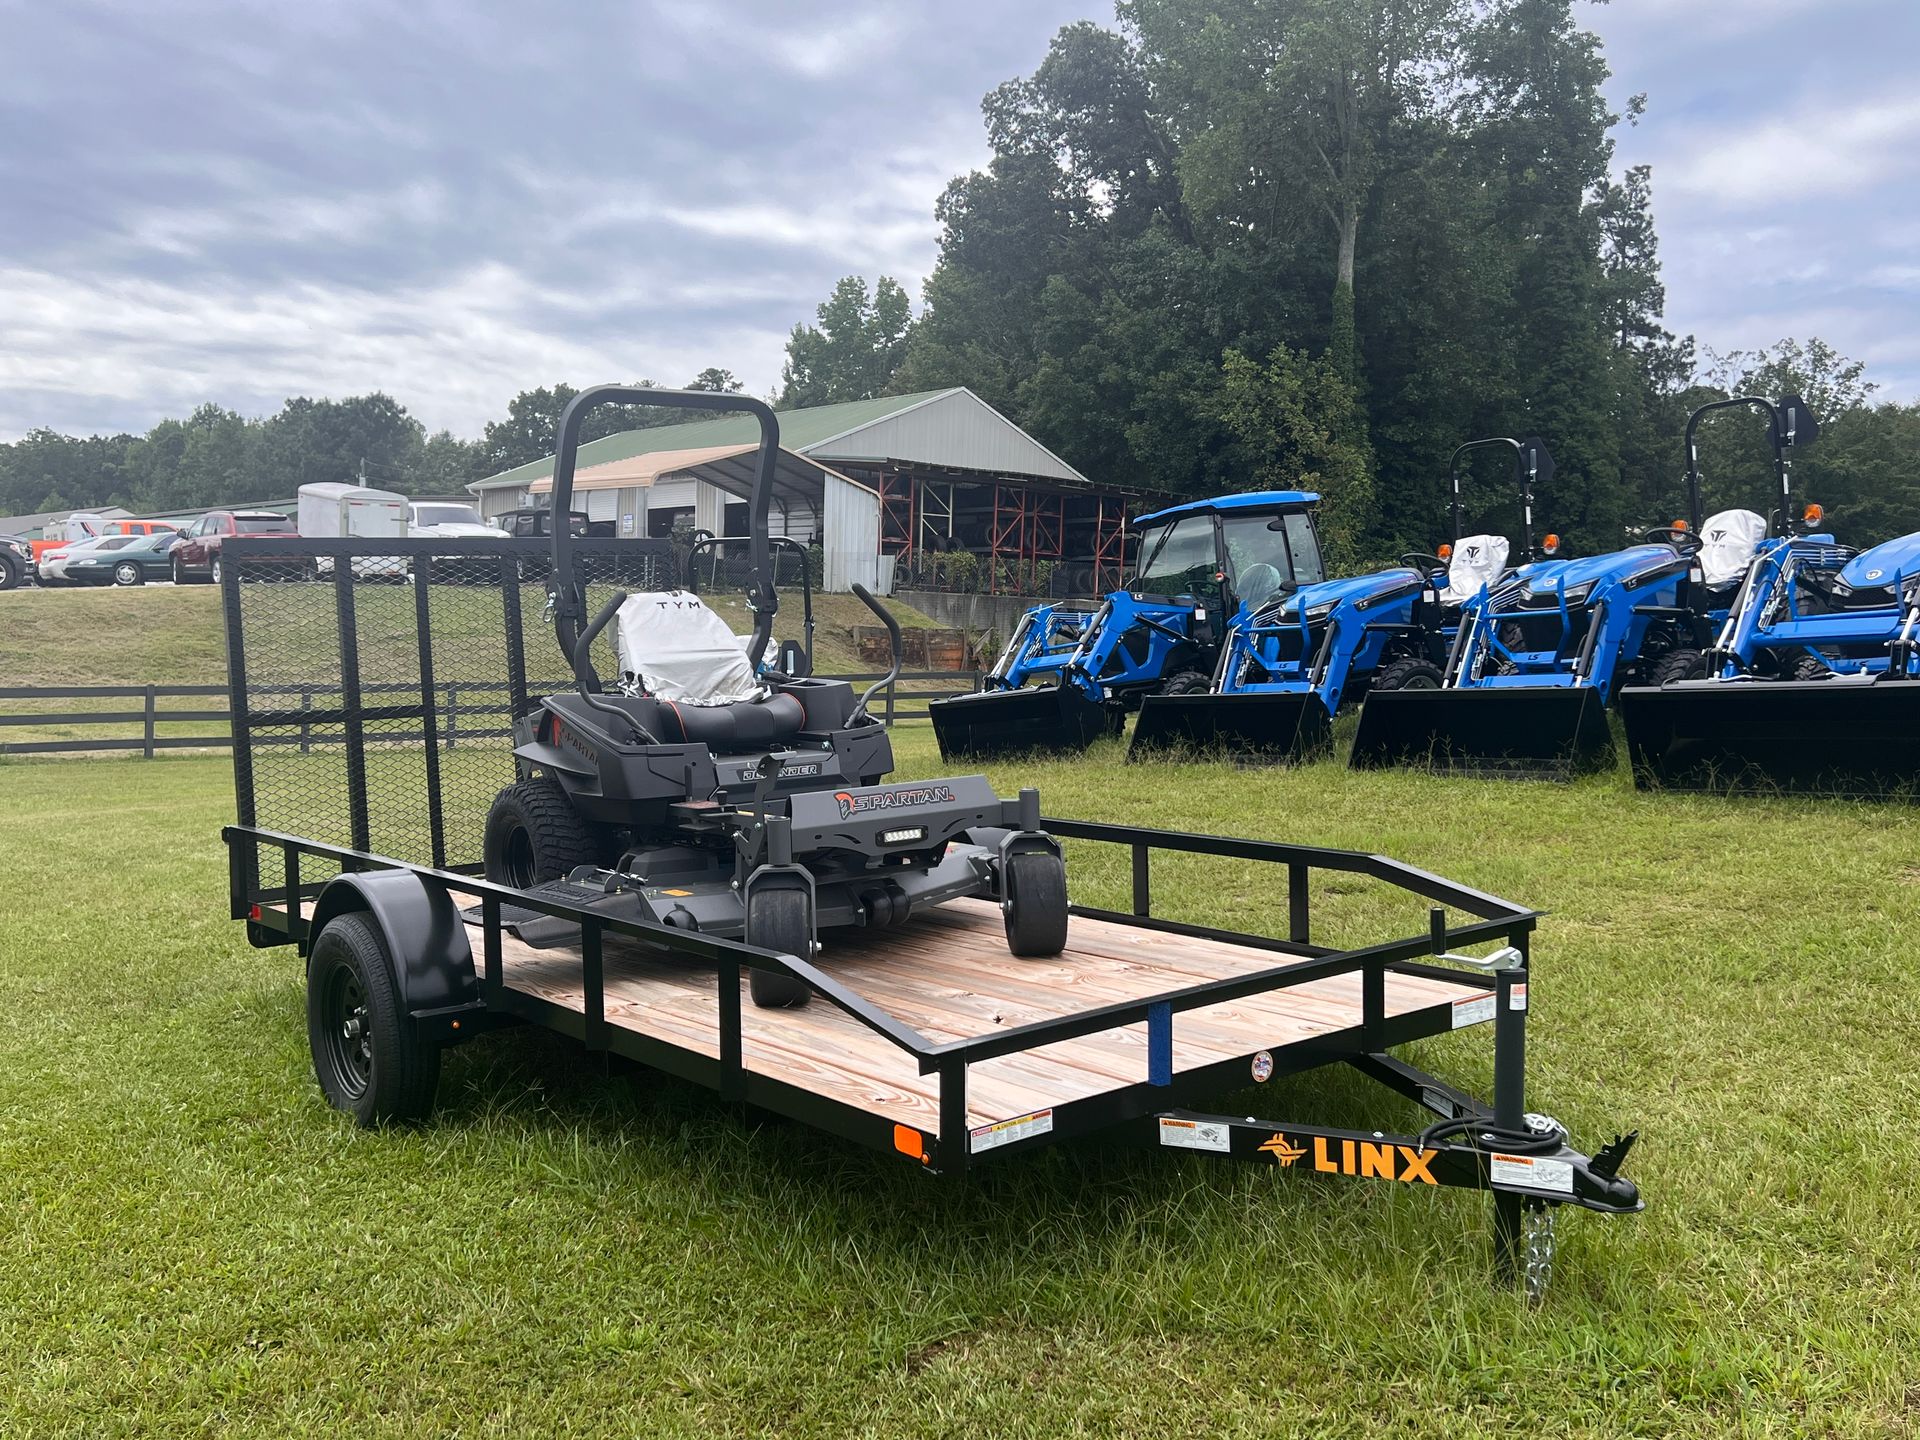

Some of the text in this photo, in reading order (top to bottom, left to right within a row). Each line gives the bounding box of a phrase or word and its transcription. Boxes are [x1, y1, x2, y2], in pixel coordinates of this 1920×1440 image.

[1134, 593, 1143, 601] LS
[656, 601, 701, 609] TYM
[1527, 653, 1541, 661] LS
[853, 786, 951, 812] SPARTAN
[1313, 1136, 1440, 1186] LINX
[1501, 1156, 1528, 1164] WARNING
